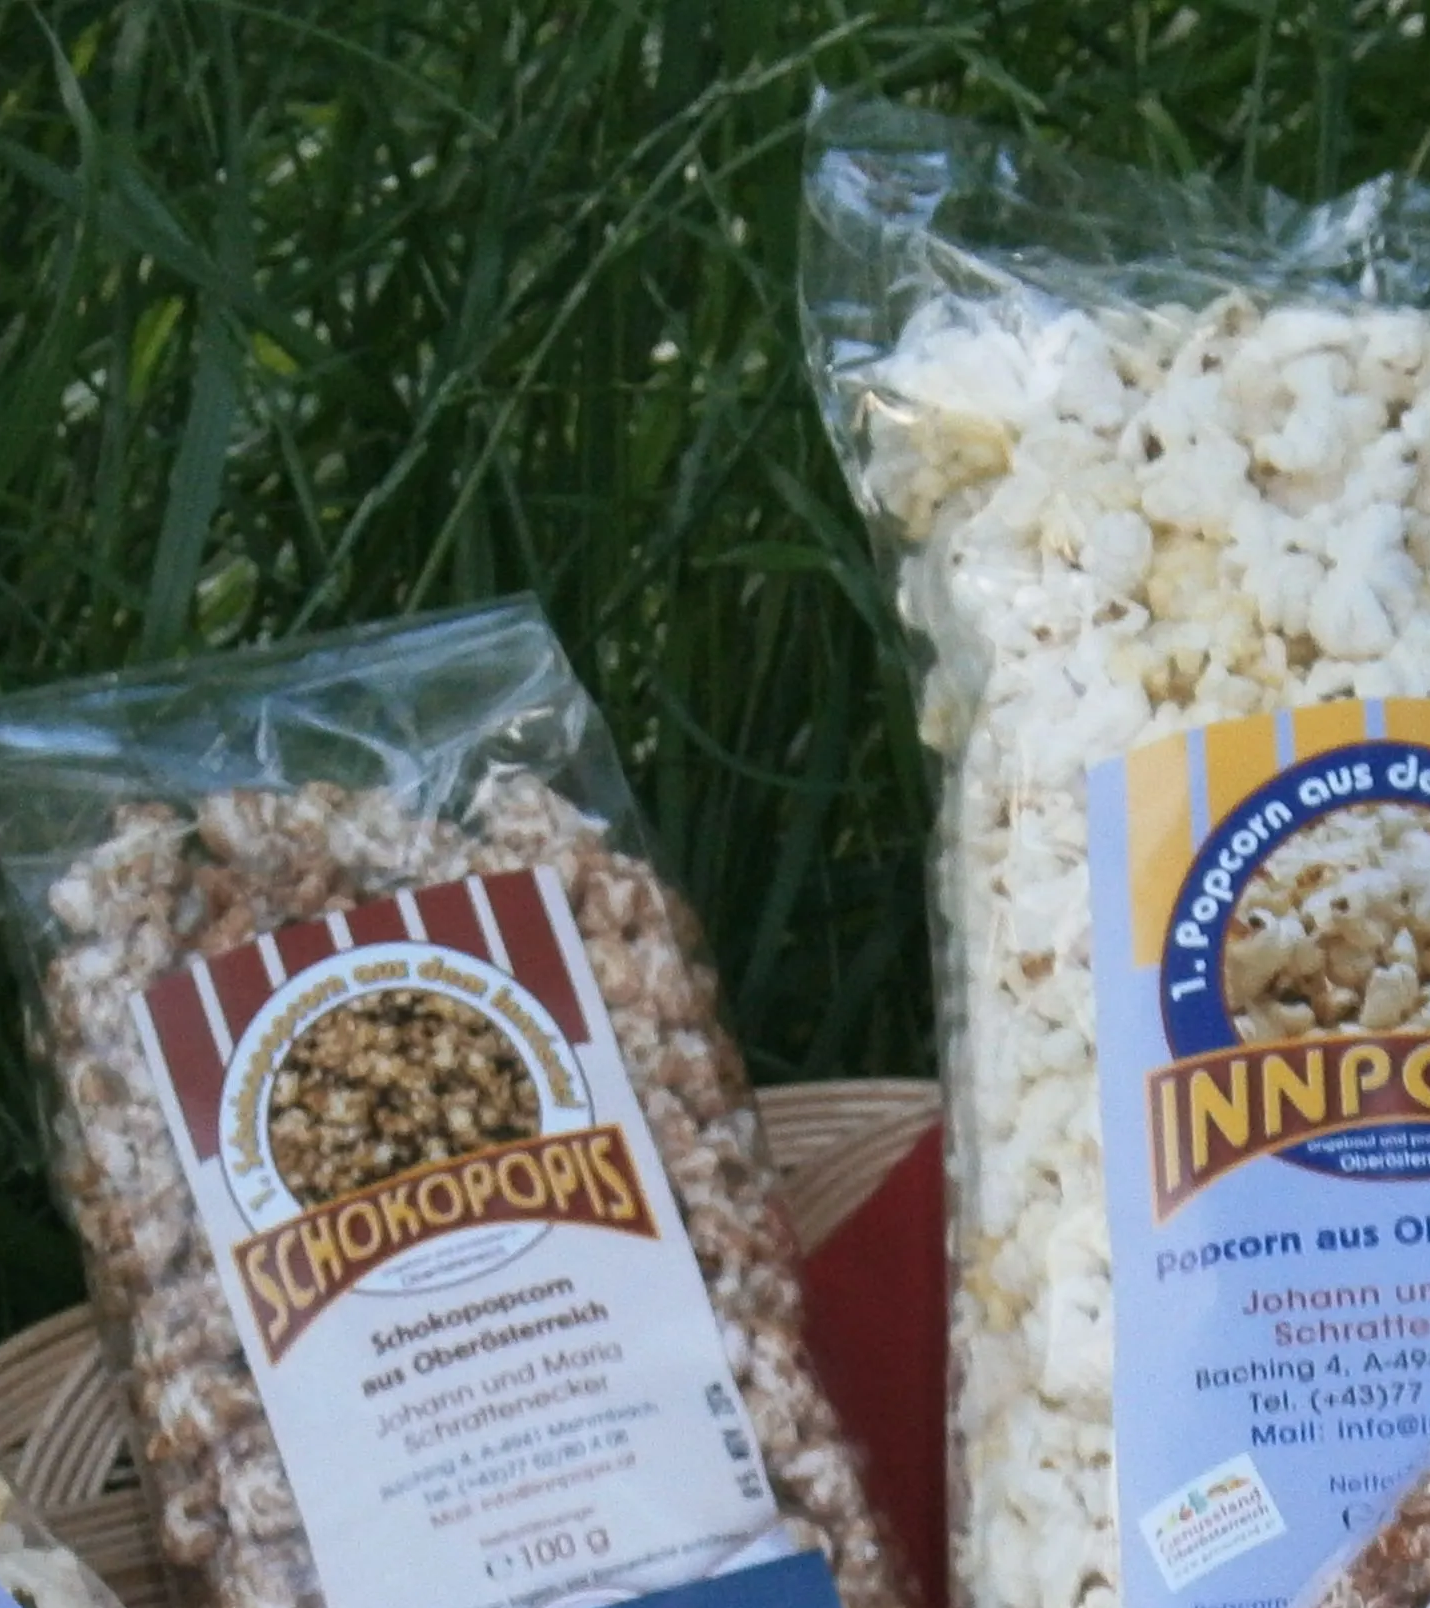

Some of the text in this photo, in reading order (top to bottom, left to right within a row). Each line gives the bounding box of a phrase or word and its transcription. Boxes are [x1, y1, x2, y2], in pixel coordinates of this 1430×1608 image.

[1176, 798, 1293, 946] Popcorn
[1298, 761, 1374, 807] aus
[244, 1135, 636, 1340] SCHOKOPOPIS
[1156, 1230, 1301, 1280] Popcorn
[1315, 1224, 1379, 1252] aus
[370, 1277, 573, 1357] Schokopopcorn
[1242, 1284, 1380, 1317] Johann
[361, 1300, 609, 1398] aus Oberösterreich
[1195, 1355, 1314, 1391] Baching
[518, 1533, 576, 1573] 100
